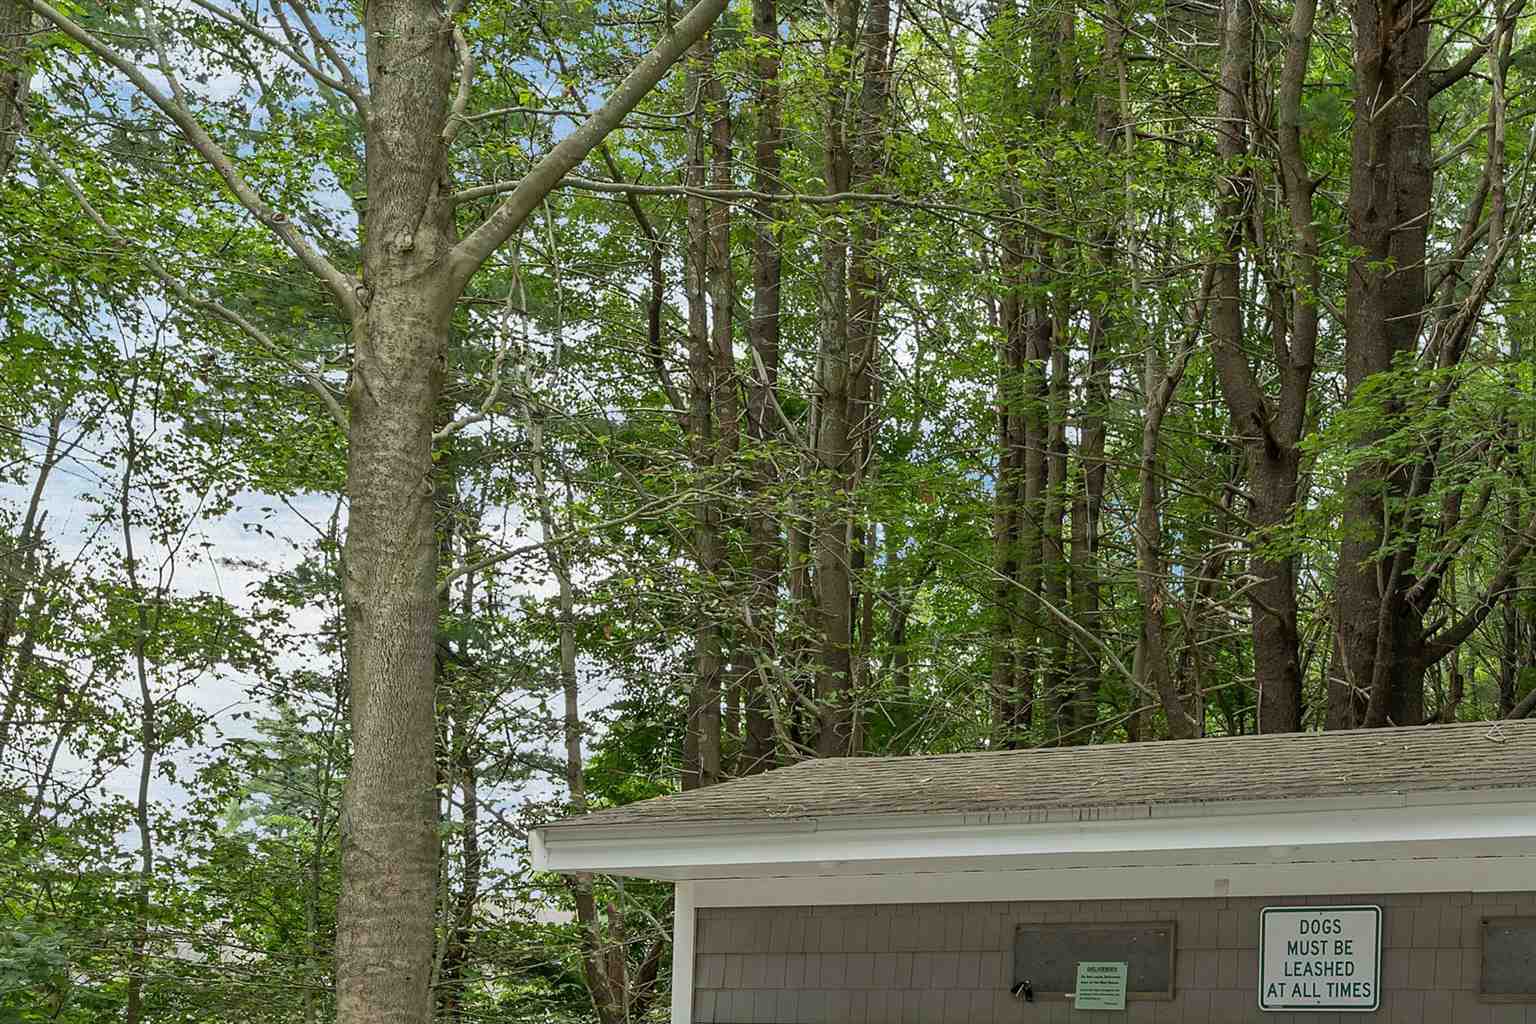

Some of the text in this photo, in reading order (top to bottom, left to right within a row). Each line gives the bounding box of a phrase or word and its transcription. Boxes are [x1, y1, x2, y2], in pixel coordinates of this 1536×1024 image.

[1300, 919, 1342, 935] DOGS
[1287, 940, 1353, 956] MUST BE
[1284, 961, 1354, 977] LEASHED
[1267, 982, 1371, 998] AT ALL TIMES
